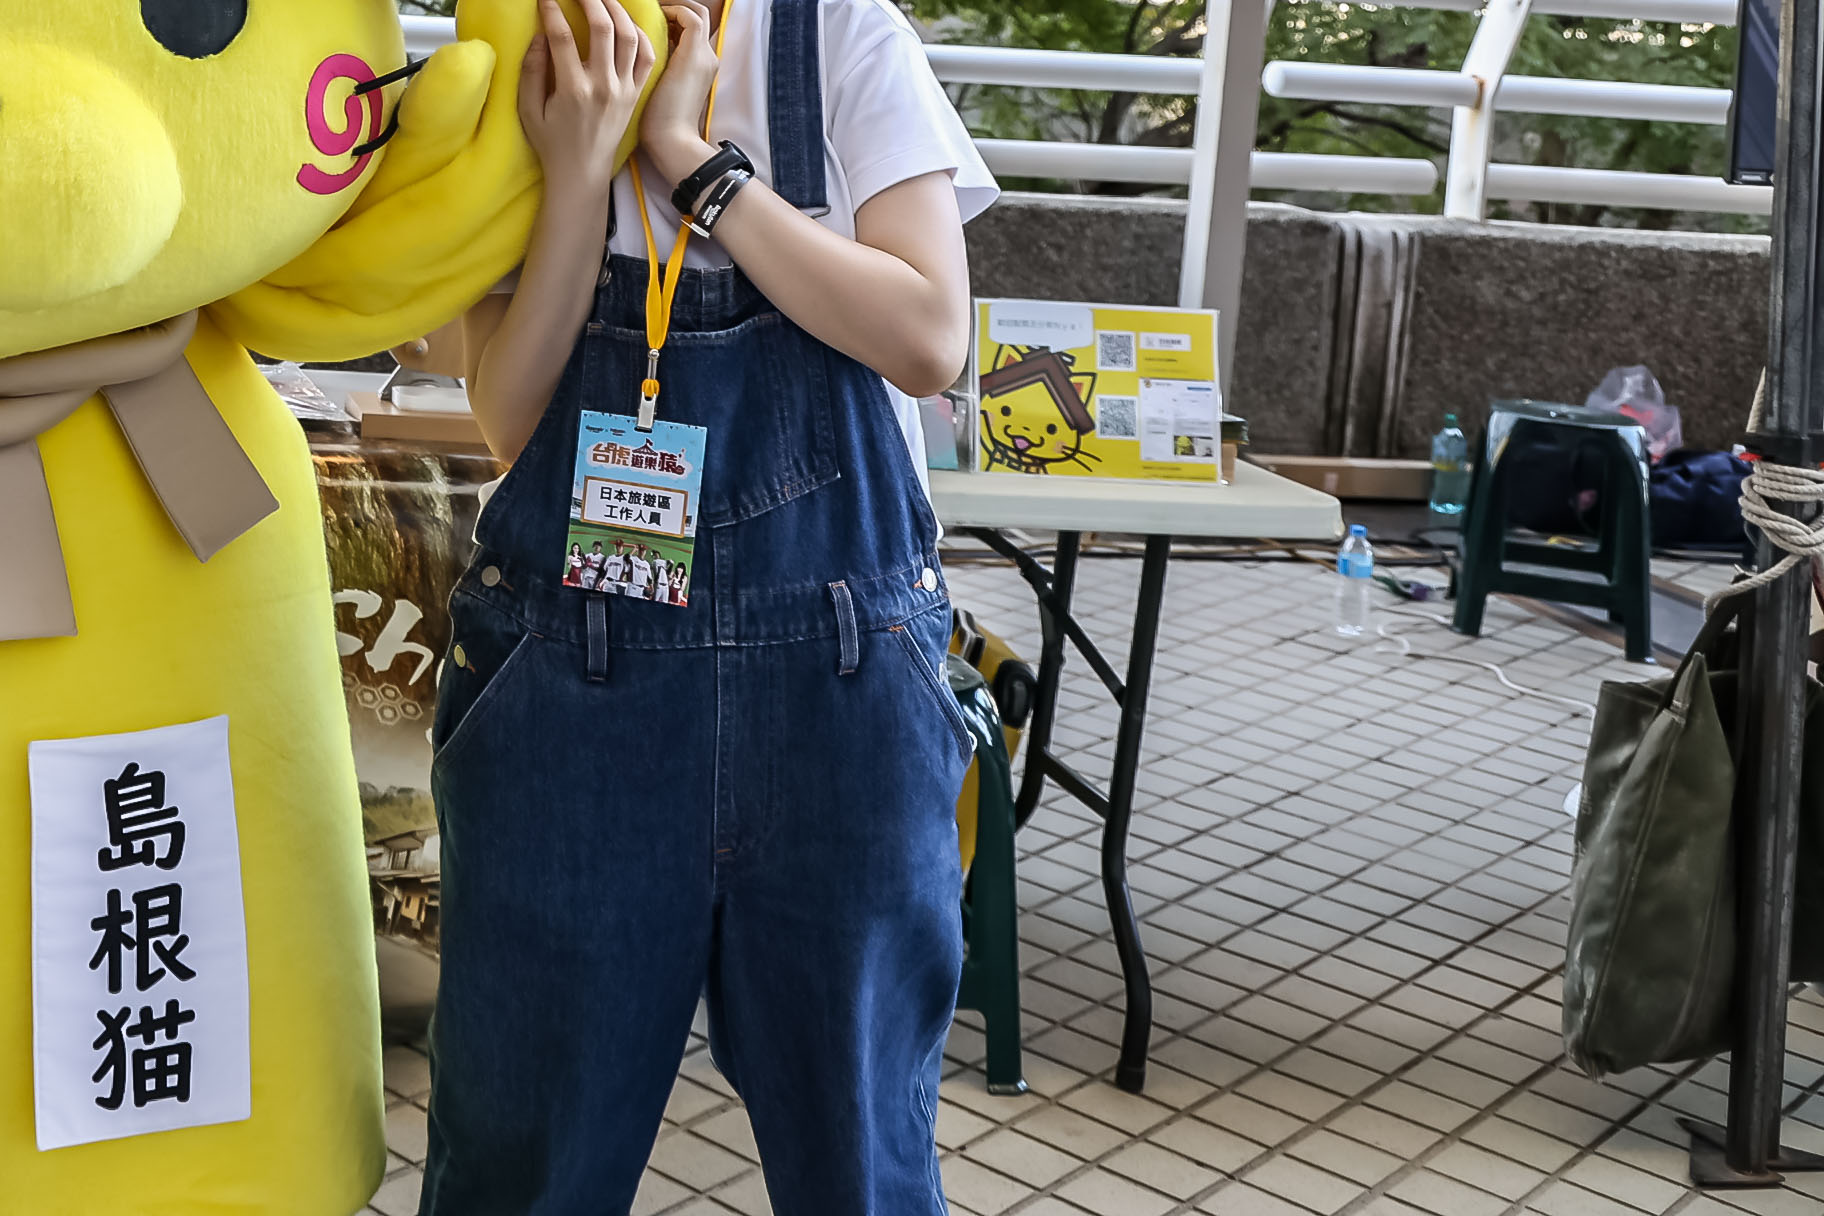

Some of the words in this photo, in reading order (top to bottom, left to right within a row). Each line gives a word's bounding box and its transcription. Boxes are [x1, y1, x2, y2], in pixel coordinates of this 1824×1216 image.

[599, 485, 673, 511] 日本旅遊區
[603, 503, 663, 527] 工作人員
[87, 761, 197, 1112] 島根猫
